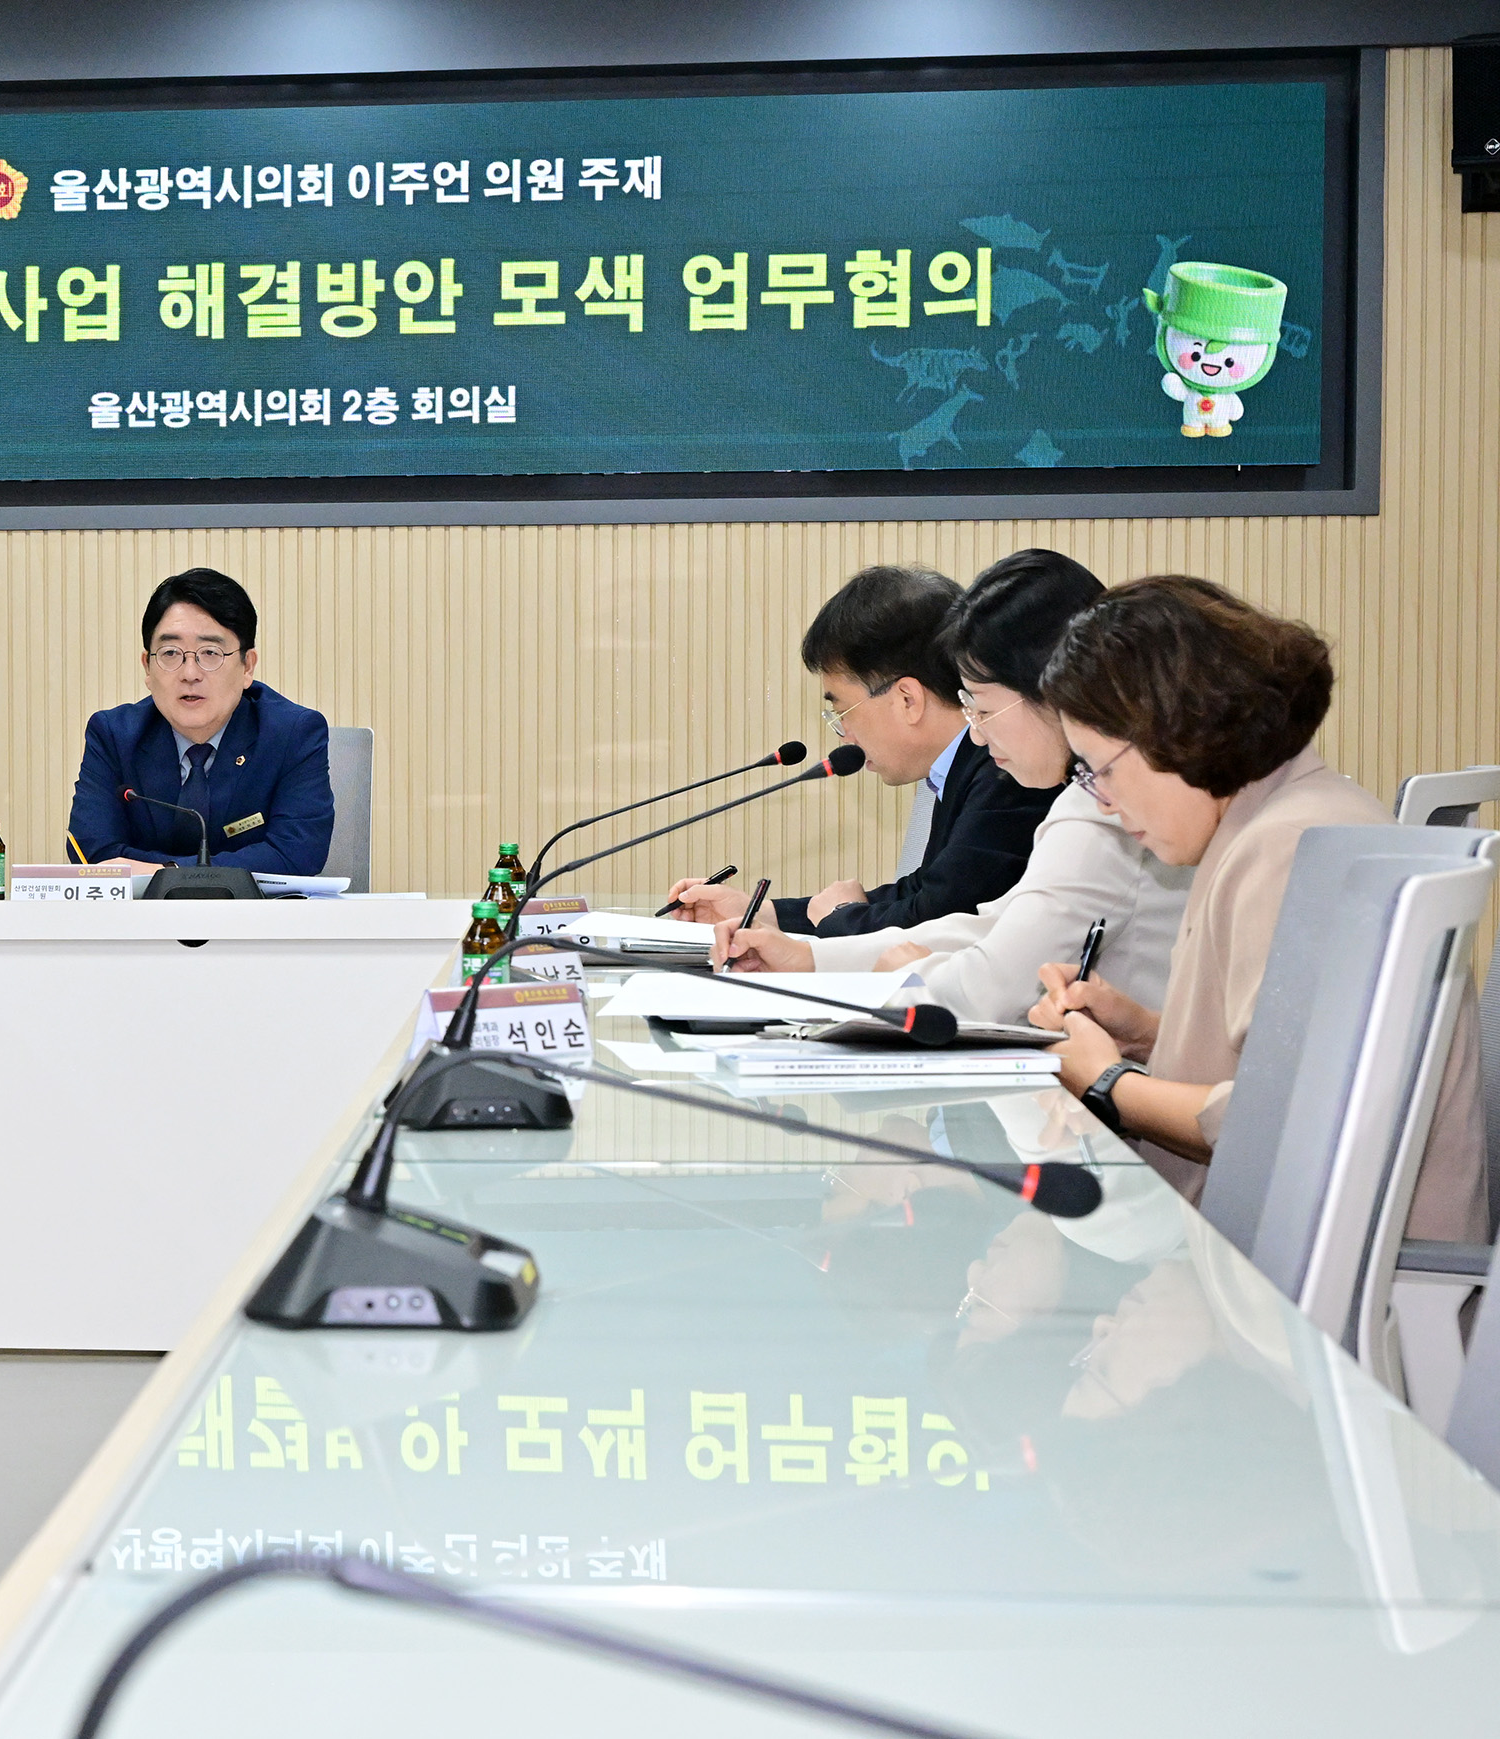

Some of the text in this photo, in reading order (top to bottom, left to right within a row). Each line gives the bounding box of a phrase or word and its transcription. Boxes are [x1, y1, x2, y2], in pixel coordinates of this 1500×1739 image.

[50, 155, 662, 212] 울산광역시의회 이주언 의원 주재
[158, 258, 463, 340] 해결방안
[493, 254, 644, 333] 모색
[681, 247, 992, 332] 업무협의
[87, 385, 517, 429] 울산광역시의회 2층 회의실
[508, 1018, 585, 1052] 석인순
